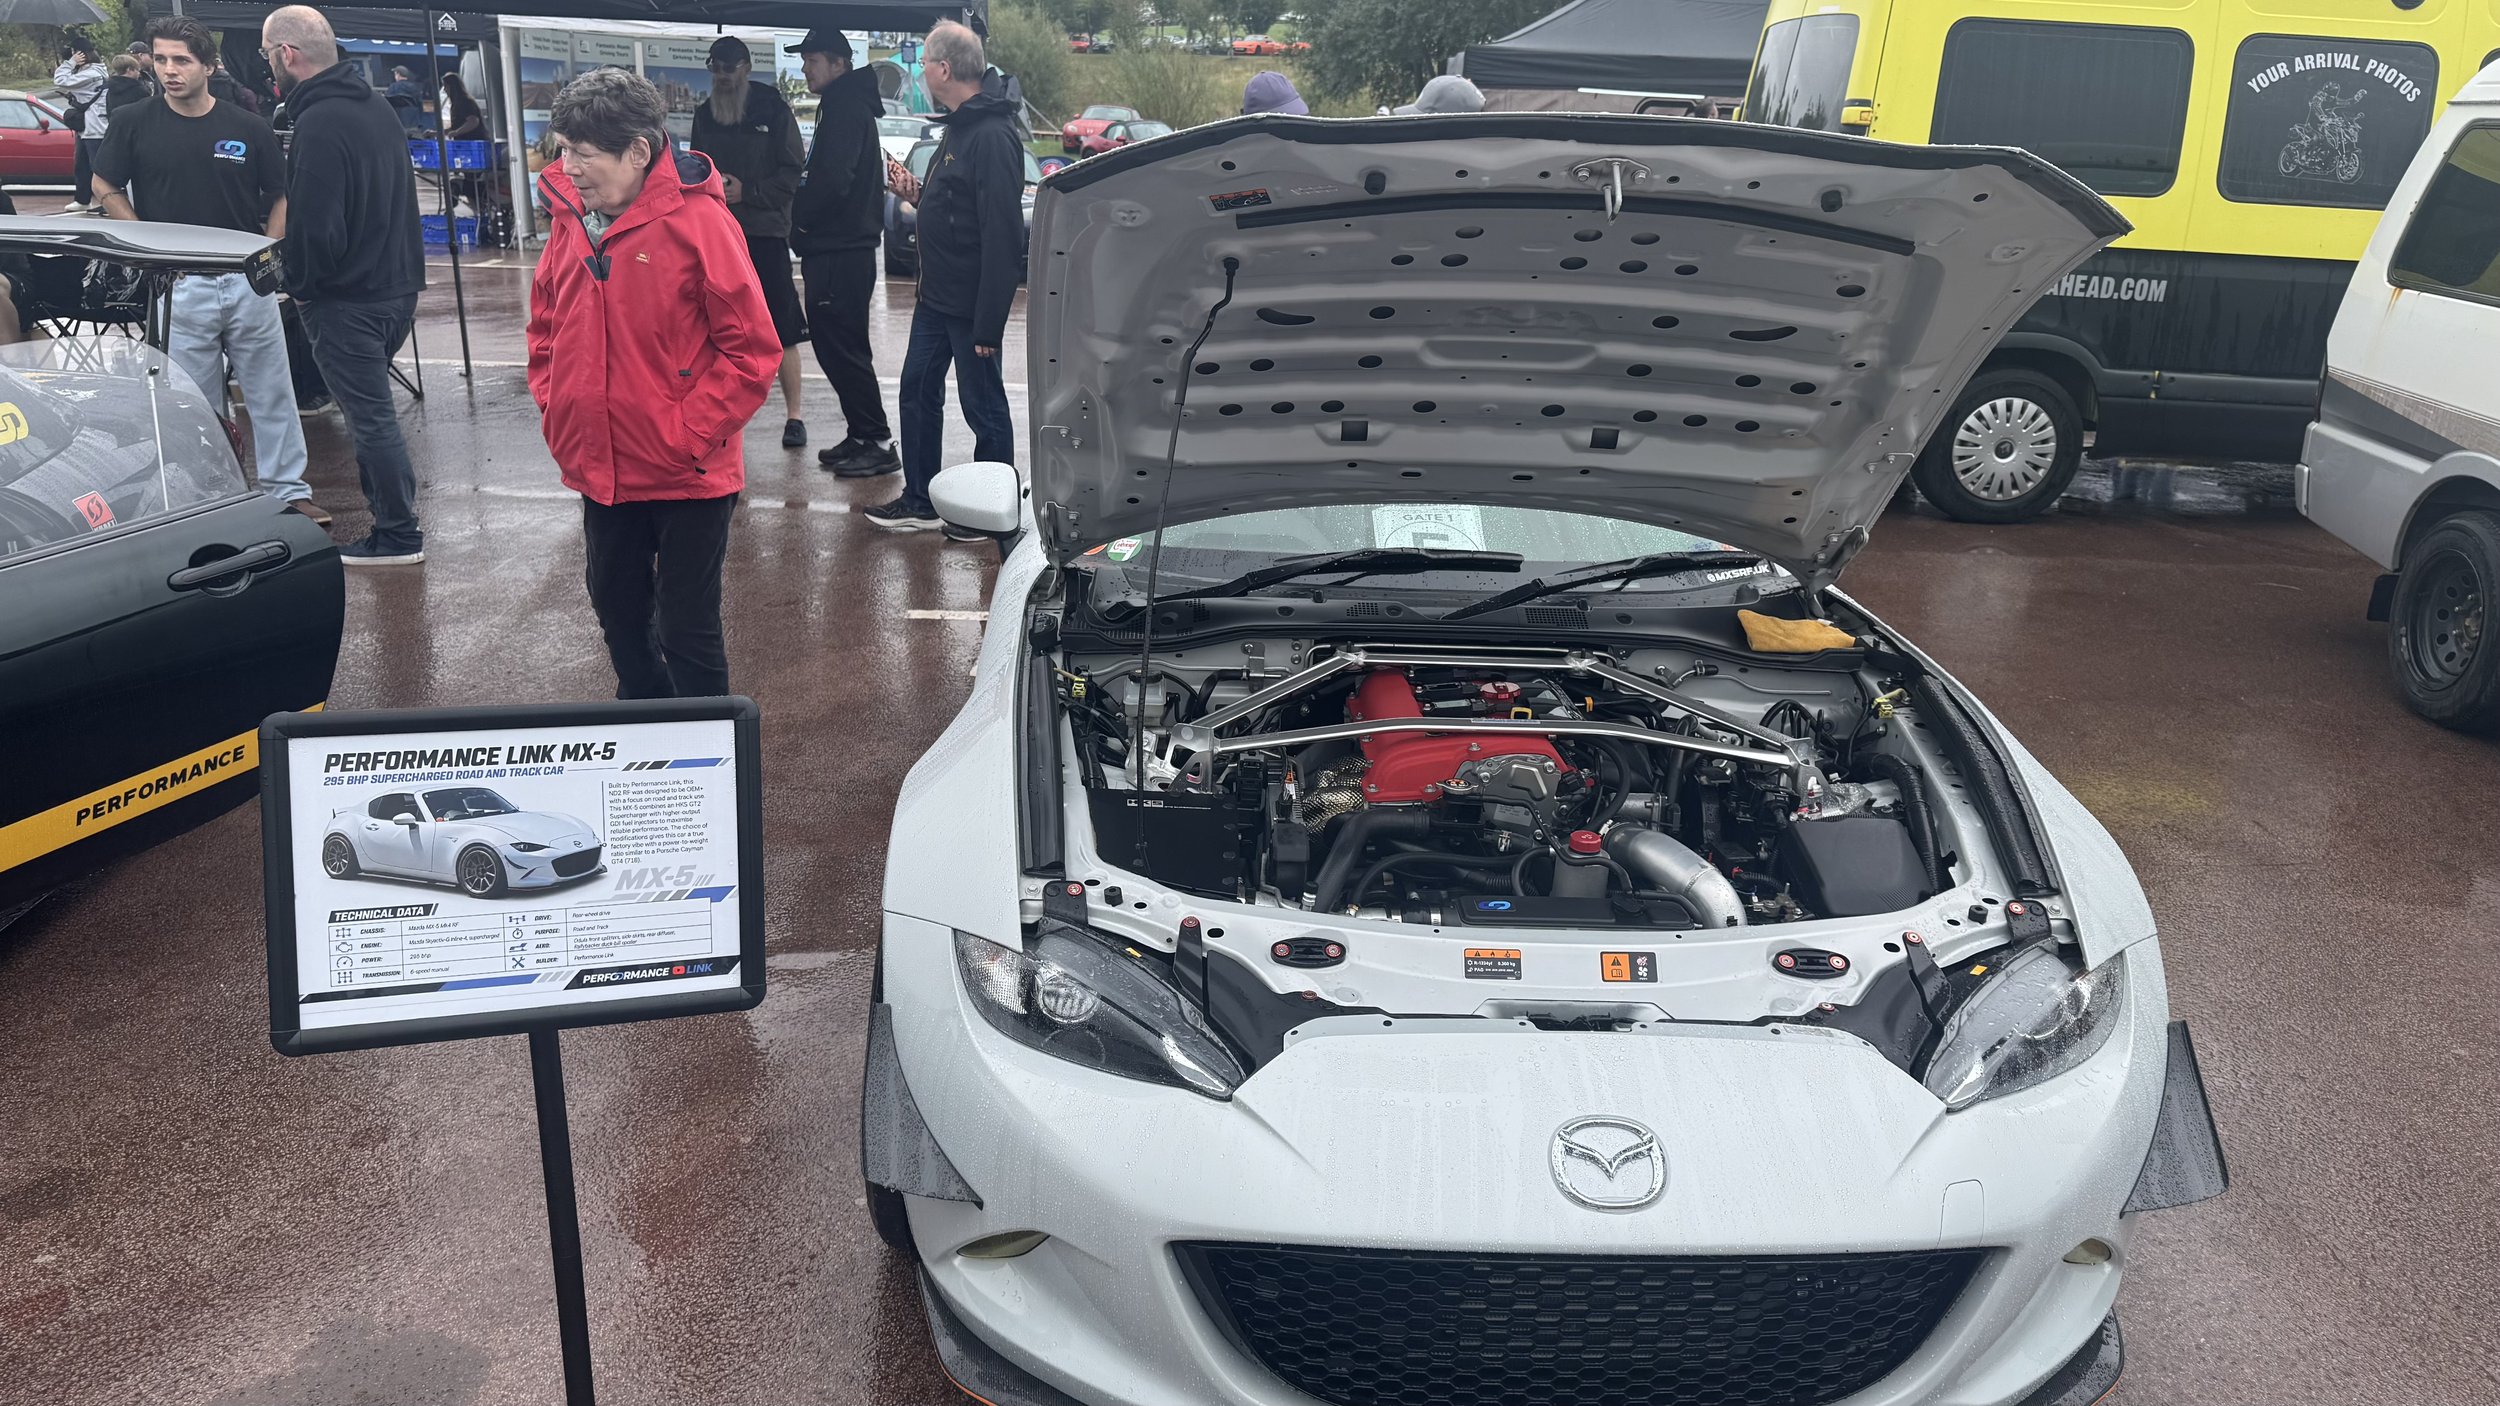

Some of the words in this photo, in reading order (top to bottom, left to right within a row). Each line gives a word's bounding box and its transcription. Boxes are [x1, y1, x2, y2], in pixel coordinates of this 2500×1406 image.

[2247, 62, 2290, 94] YOUR
[2294, 52, 2361, 72] ARRIVAL
[2364, 58, 2422, 102] PHOTOS
[324, 746, 502, 773] PERFORMANCE
[506, 744, 557, 764] LINK
[560, 742, 616, 762] MX-5
[76, 744, 245, 826] PERFORMANCE
[324, 776, 344, 786] 295
[347, 775, 368, 785] BHP
[370, 770, 453, 784] SUPERCHARGED
[455, 769, 483, 780] ROAD
[485, 768, 506, 778] AND
[509, 766, 542, 777] TRACK
[543, 766, 564, 775] CAR
[614, 865, 696, 890] MX-5
[334, 908, 394, 921] TECHNICAL
[396, 906, 424, 917] DATA
[583, 967, 670, 984] PERFORMANCE
[686, 962, 714, 974] LINK
